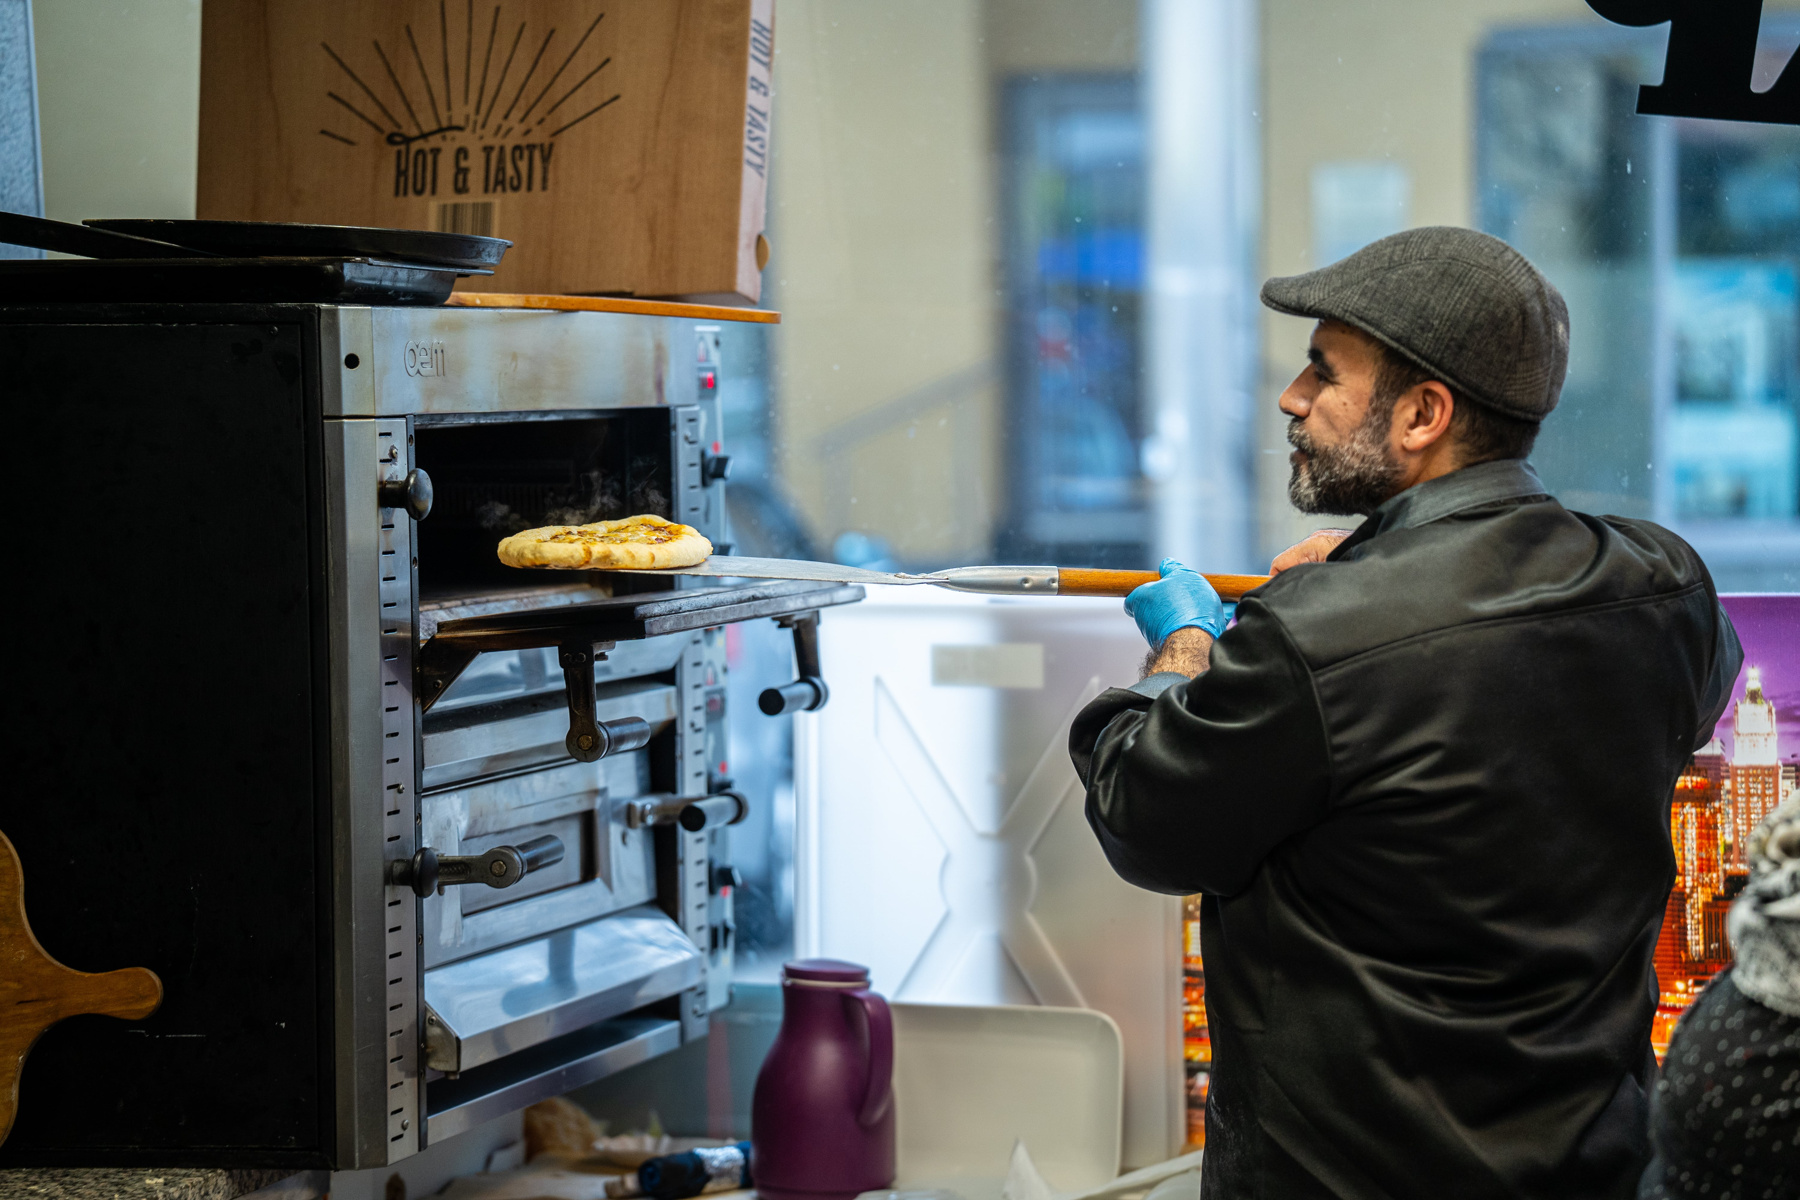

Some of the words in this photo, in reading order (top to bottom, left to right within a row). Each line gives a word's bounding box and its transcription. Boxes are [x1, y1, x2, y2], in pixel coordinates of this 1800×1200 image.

[751, 19, 772, 71] HOT
[749, 76, 770, 97] &
[745, 104, 768, 178] TASTY
[394, 142, 443, 197] HOT
[454, 146, 470, 194] &
[482, 142, 554, 194] TASTY
